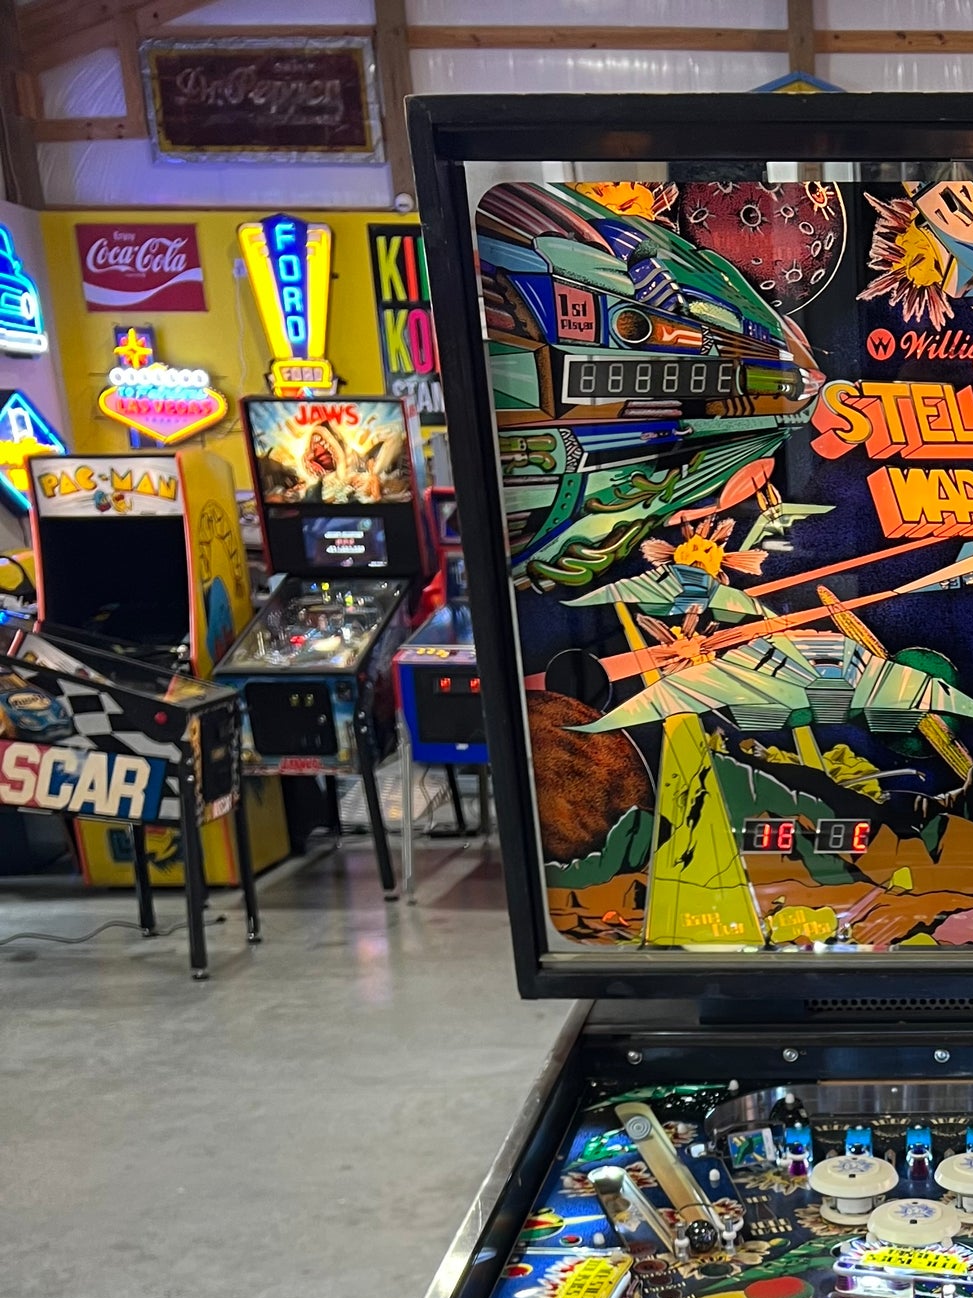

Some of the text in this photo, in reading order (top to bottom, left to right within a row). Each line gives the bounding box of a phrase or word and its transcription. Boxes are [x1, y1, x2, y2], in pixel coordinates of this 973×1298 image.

[86, 236, 189, 273] Coca-Cola
[275, 222, 307, 345] FORD
[384, 308, 440, 374] KO
[116, 399, 212, 415] LAS VEGAS
[294, 403, 361, 426] JAWS
[38, 465, 178, 501] PAC-MAN
